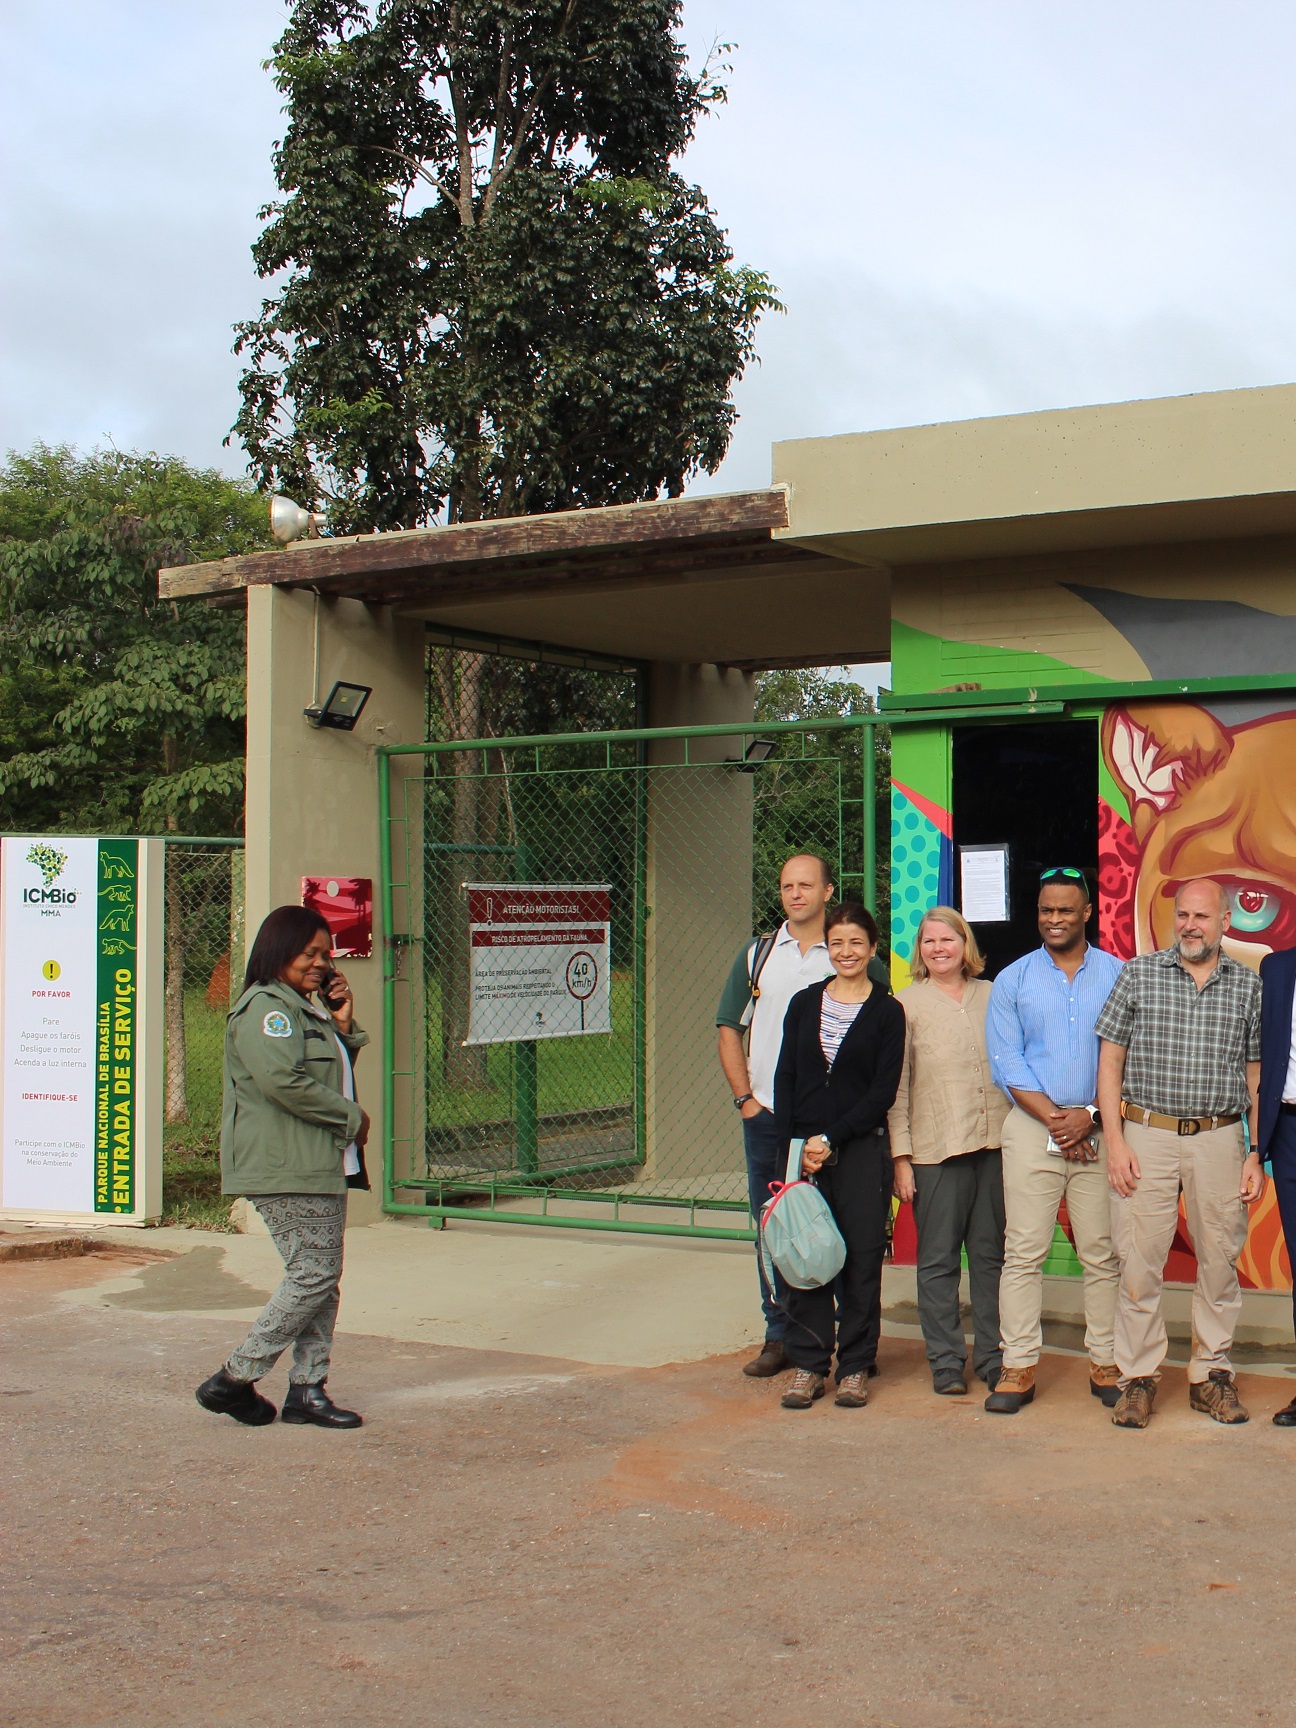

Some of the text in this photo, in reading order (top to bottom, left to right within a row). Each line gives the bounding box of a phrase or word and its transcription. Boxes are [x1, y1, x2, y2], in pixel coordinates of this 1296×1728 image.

[23, 888, 77, 904] ICMBio
[574, 962, 588, 977] 40
[572, 977, 592, 988] km/h
[32, 990, 46, 998] POR
[42, 1017, 60, 1026] Pare
[21, 1030, 48, 1041] Apague
[60, 1031, 81, 1040] faróis
[20, 1044, 51, 1055] Desligue
[60, 1046, 81, 1054] motor
[14, 1058, 41, 1067] Acenda
[48, 1059, 60, 1067] luz
[61, 1060, 87, 1068] interna
[113, 968, 136, 1204] ENTRADA DE SERVIÇO
[22, 1092, 78, 1102] IDENTIFIQUE-SE
[97, 1001, 110, 1203] PARQUE NACIONAL DE BRASÍLIA
[14, 1138, 42, 1148] Participe
[63, 1141, 86, 1149] ICMBio
[30, 1149, 70, 1158] conservação
[26, 1158, 73, 1167] Meio Ambiente
